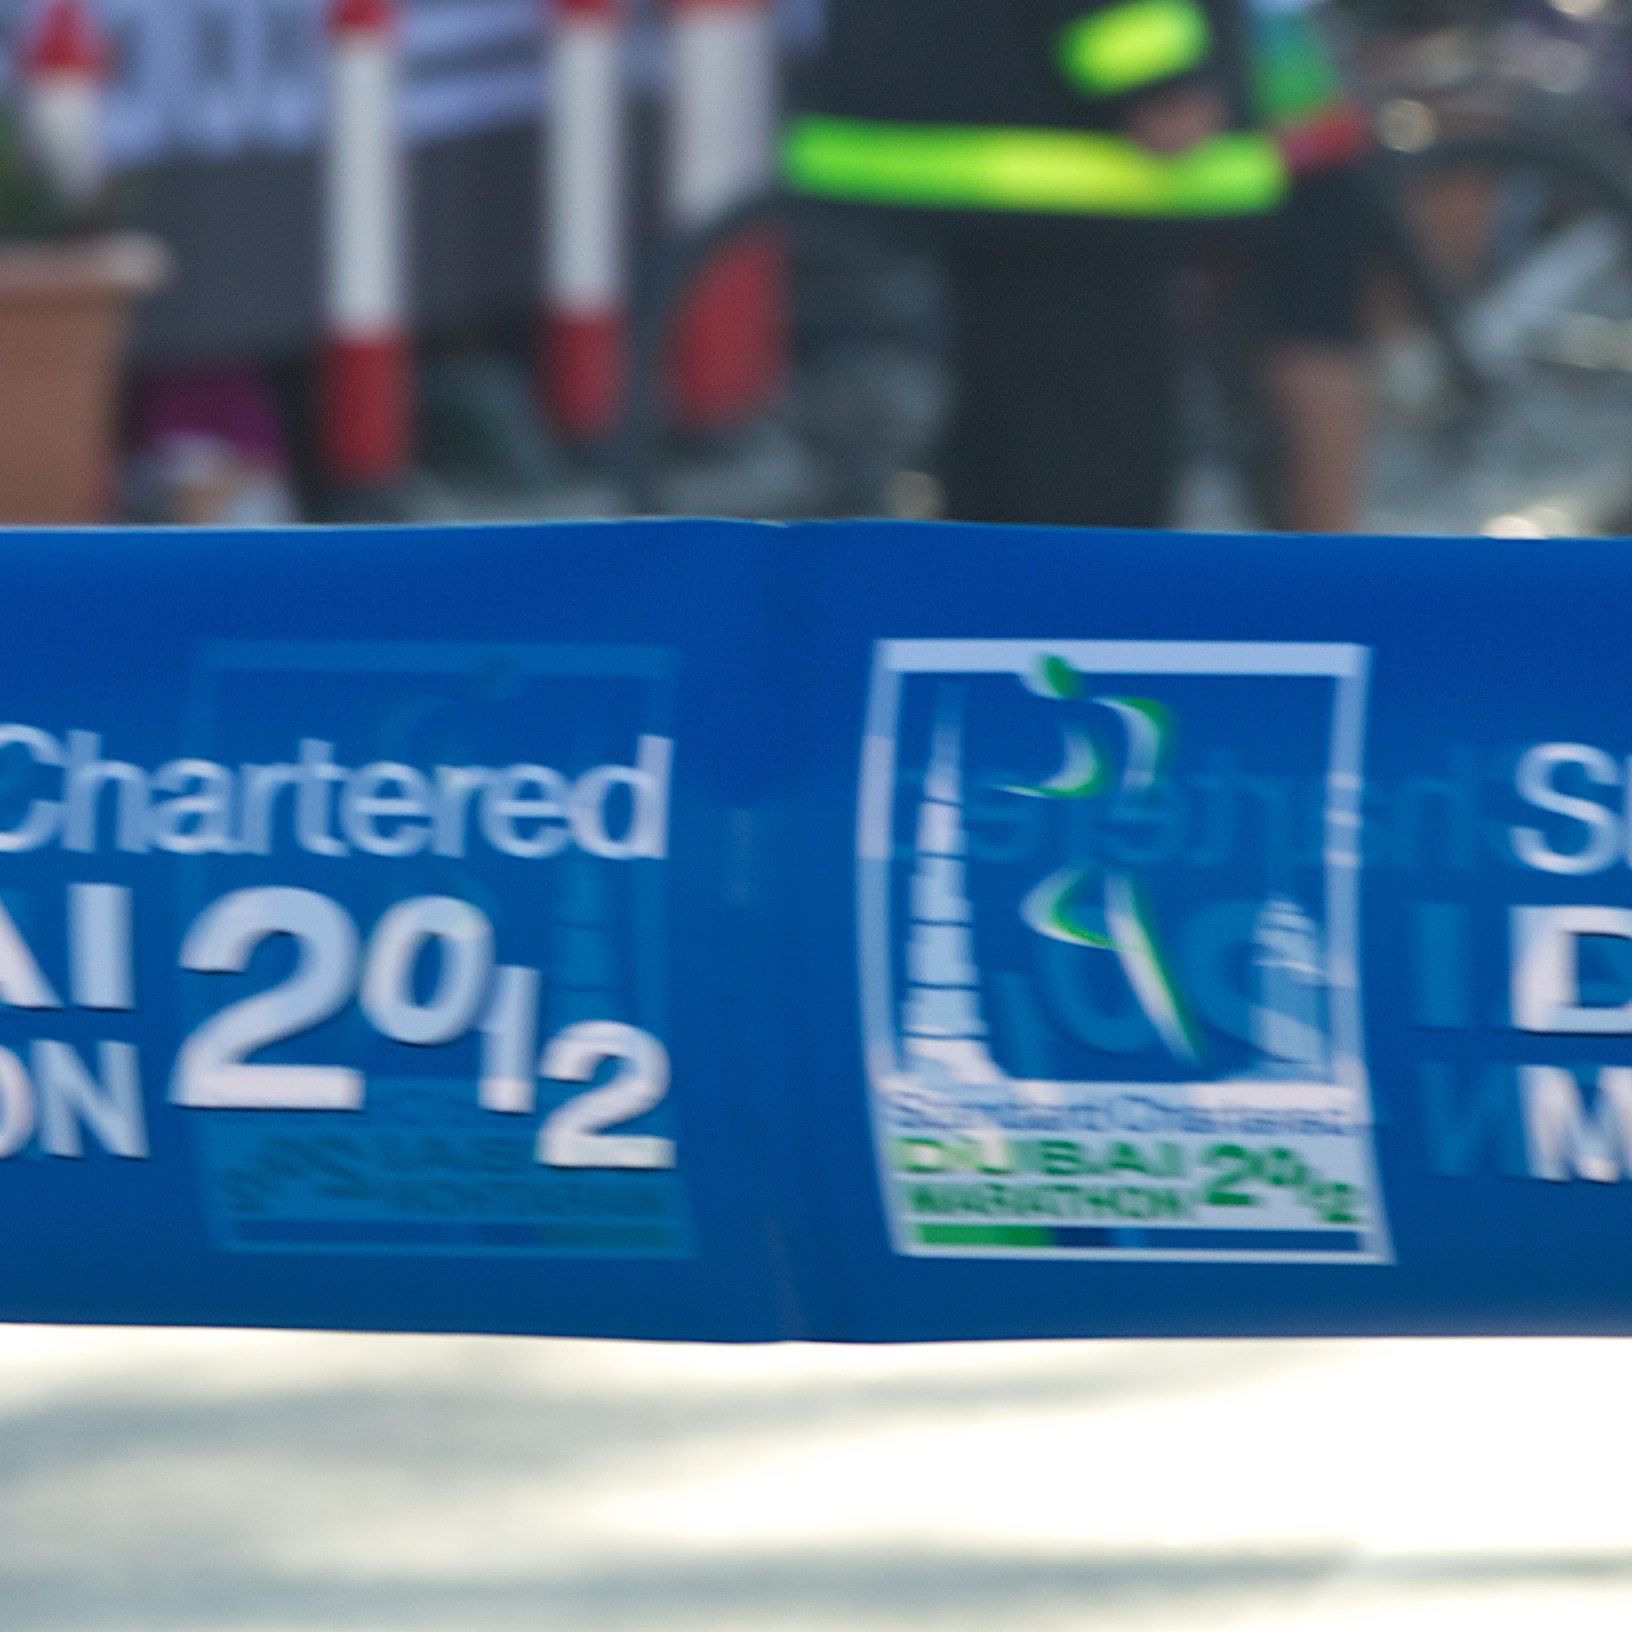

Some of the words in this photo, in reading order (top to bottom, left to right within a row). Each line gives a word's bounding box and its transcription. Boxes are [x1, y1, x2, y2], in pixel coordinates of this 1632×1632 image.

[1508, 742, 1632, 876] S
[167, 885, 677, 1170] 2012
[889, 1135, 1189, 1177] DUBAI
